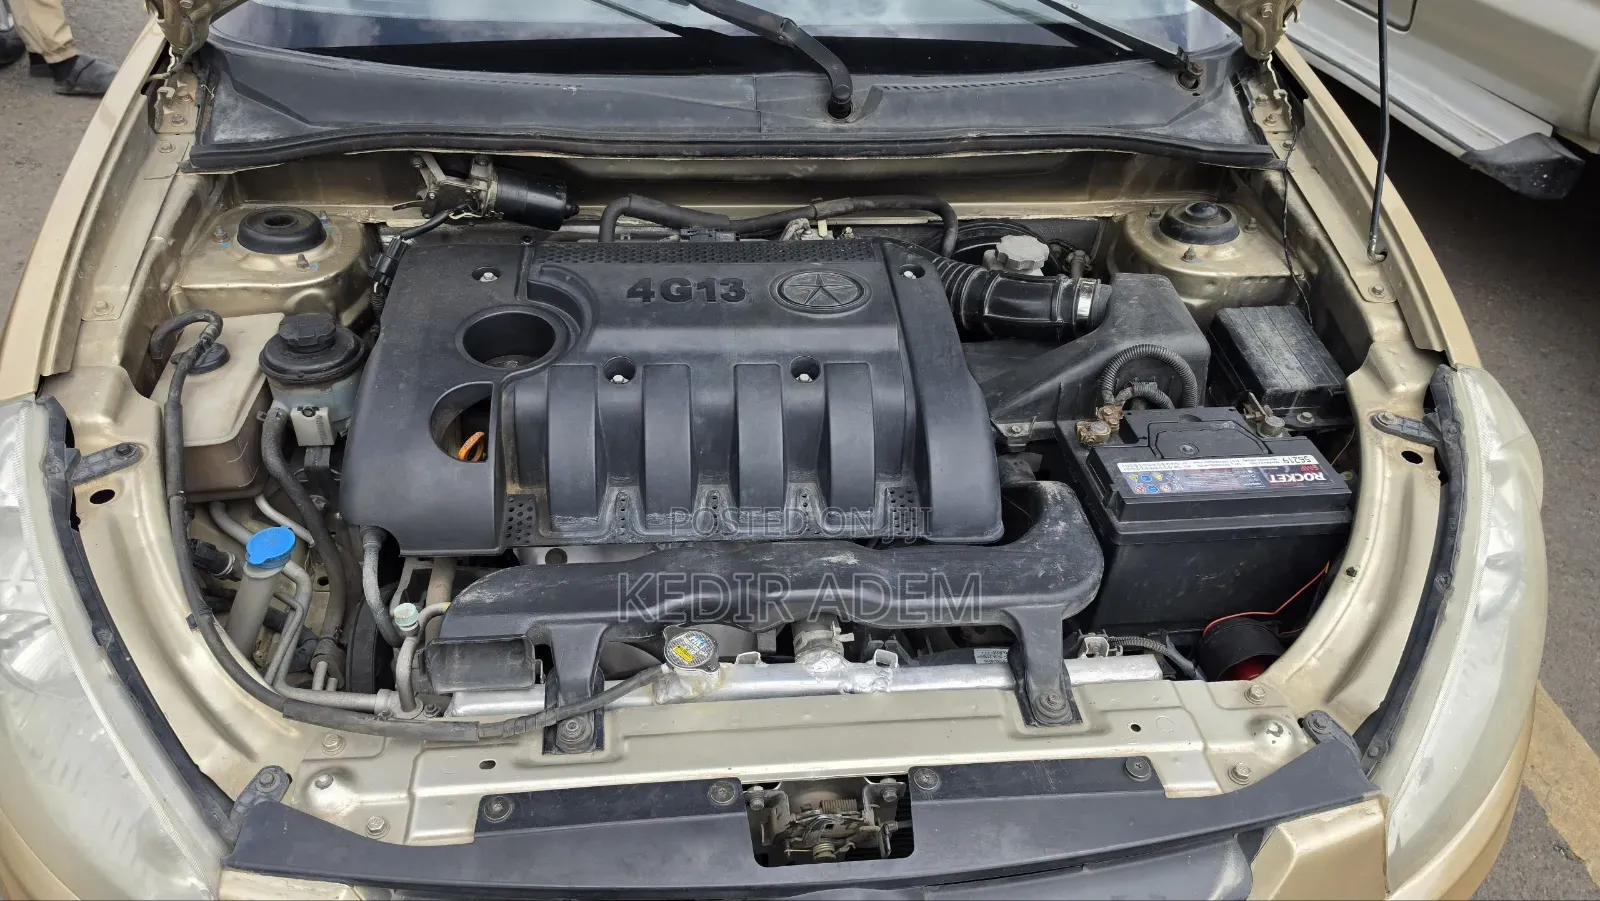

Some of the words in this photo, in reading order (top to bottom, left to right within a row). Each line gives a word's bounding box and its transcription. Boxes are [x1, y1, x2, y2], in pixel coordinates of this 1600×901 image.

[626, 277, 746, 303] 4G13
[1282, 455, 1312, 464] 56219
[1268, 471, 1327, 484] ROCKET
